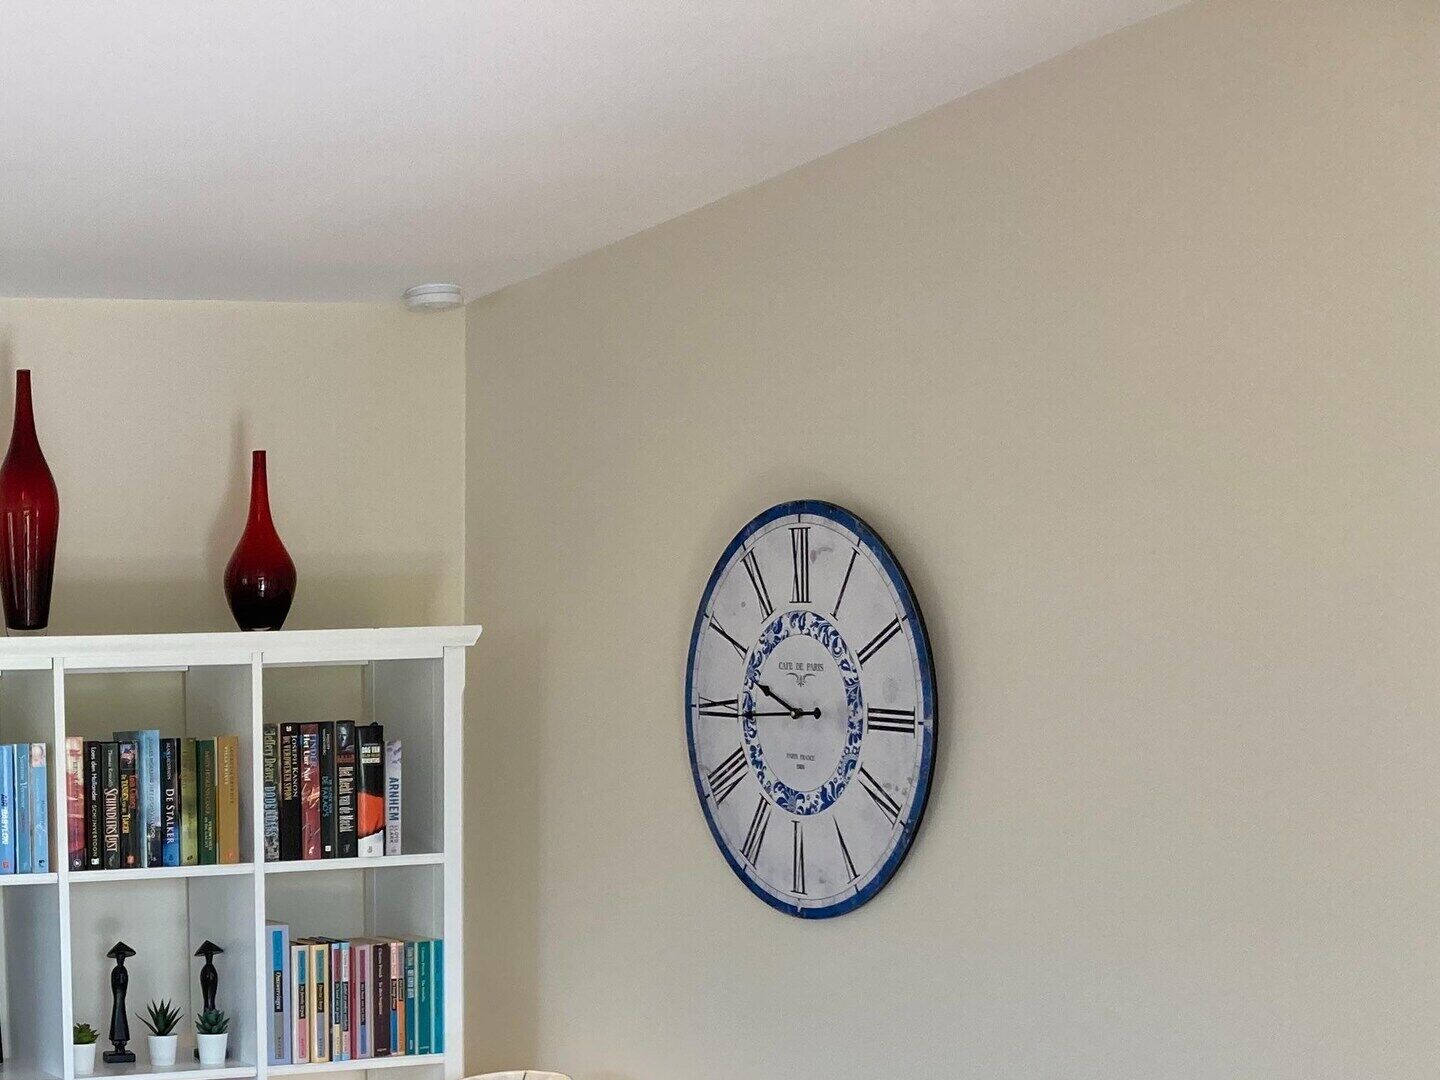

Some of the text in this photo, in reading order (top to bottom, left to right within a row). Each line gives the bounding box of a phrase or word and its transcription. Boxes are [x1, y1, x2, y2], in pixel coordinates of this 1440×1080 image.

[807, 663, 824, 672] PARIS
[263, 730, 277, 783] Jeffery Deaver
[302, 734, 310, 748] Het
[105, 788, 119, 853] SCHINDLERS LIJST
[165, 788, 176, 844] DE STALKER
[388, 778, 399, 821] ARNHEM
[1, 808, 10, 844] BABYLON
